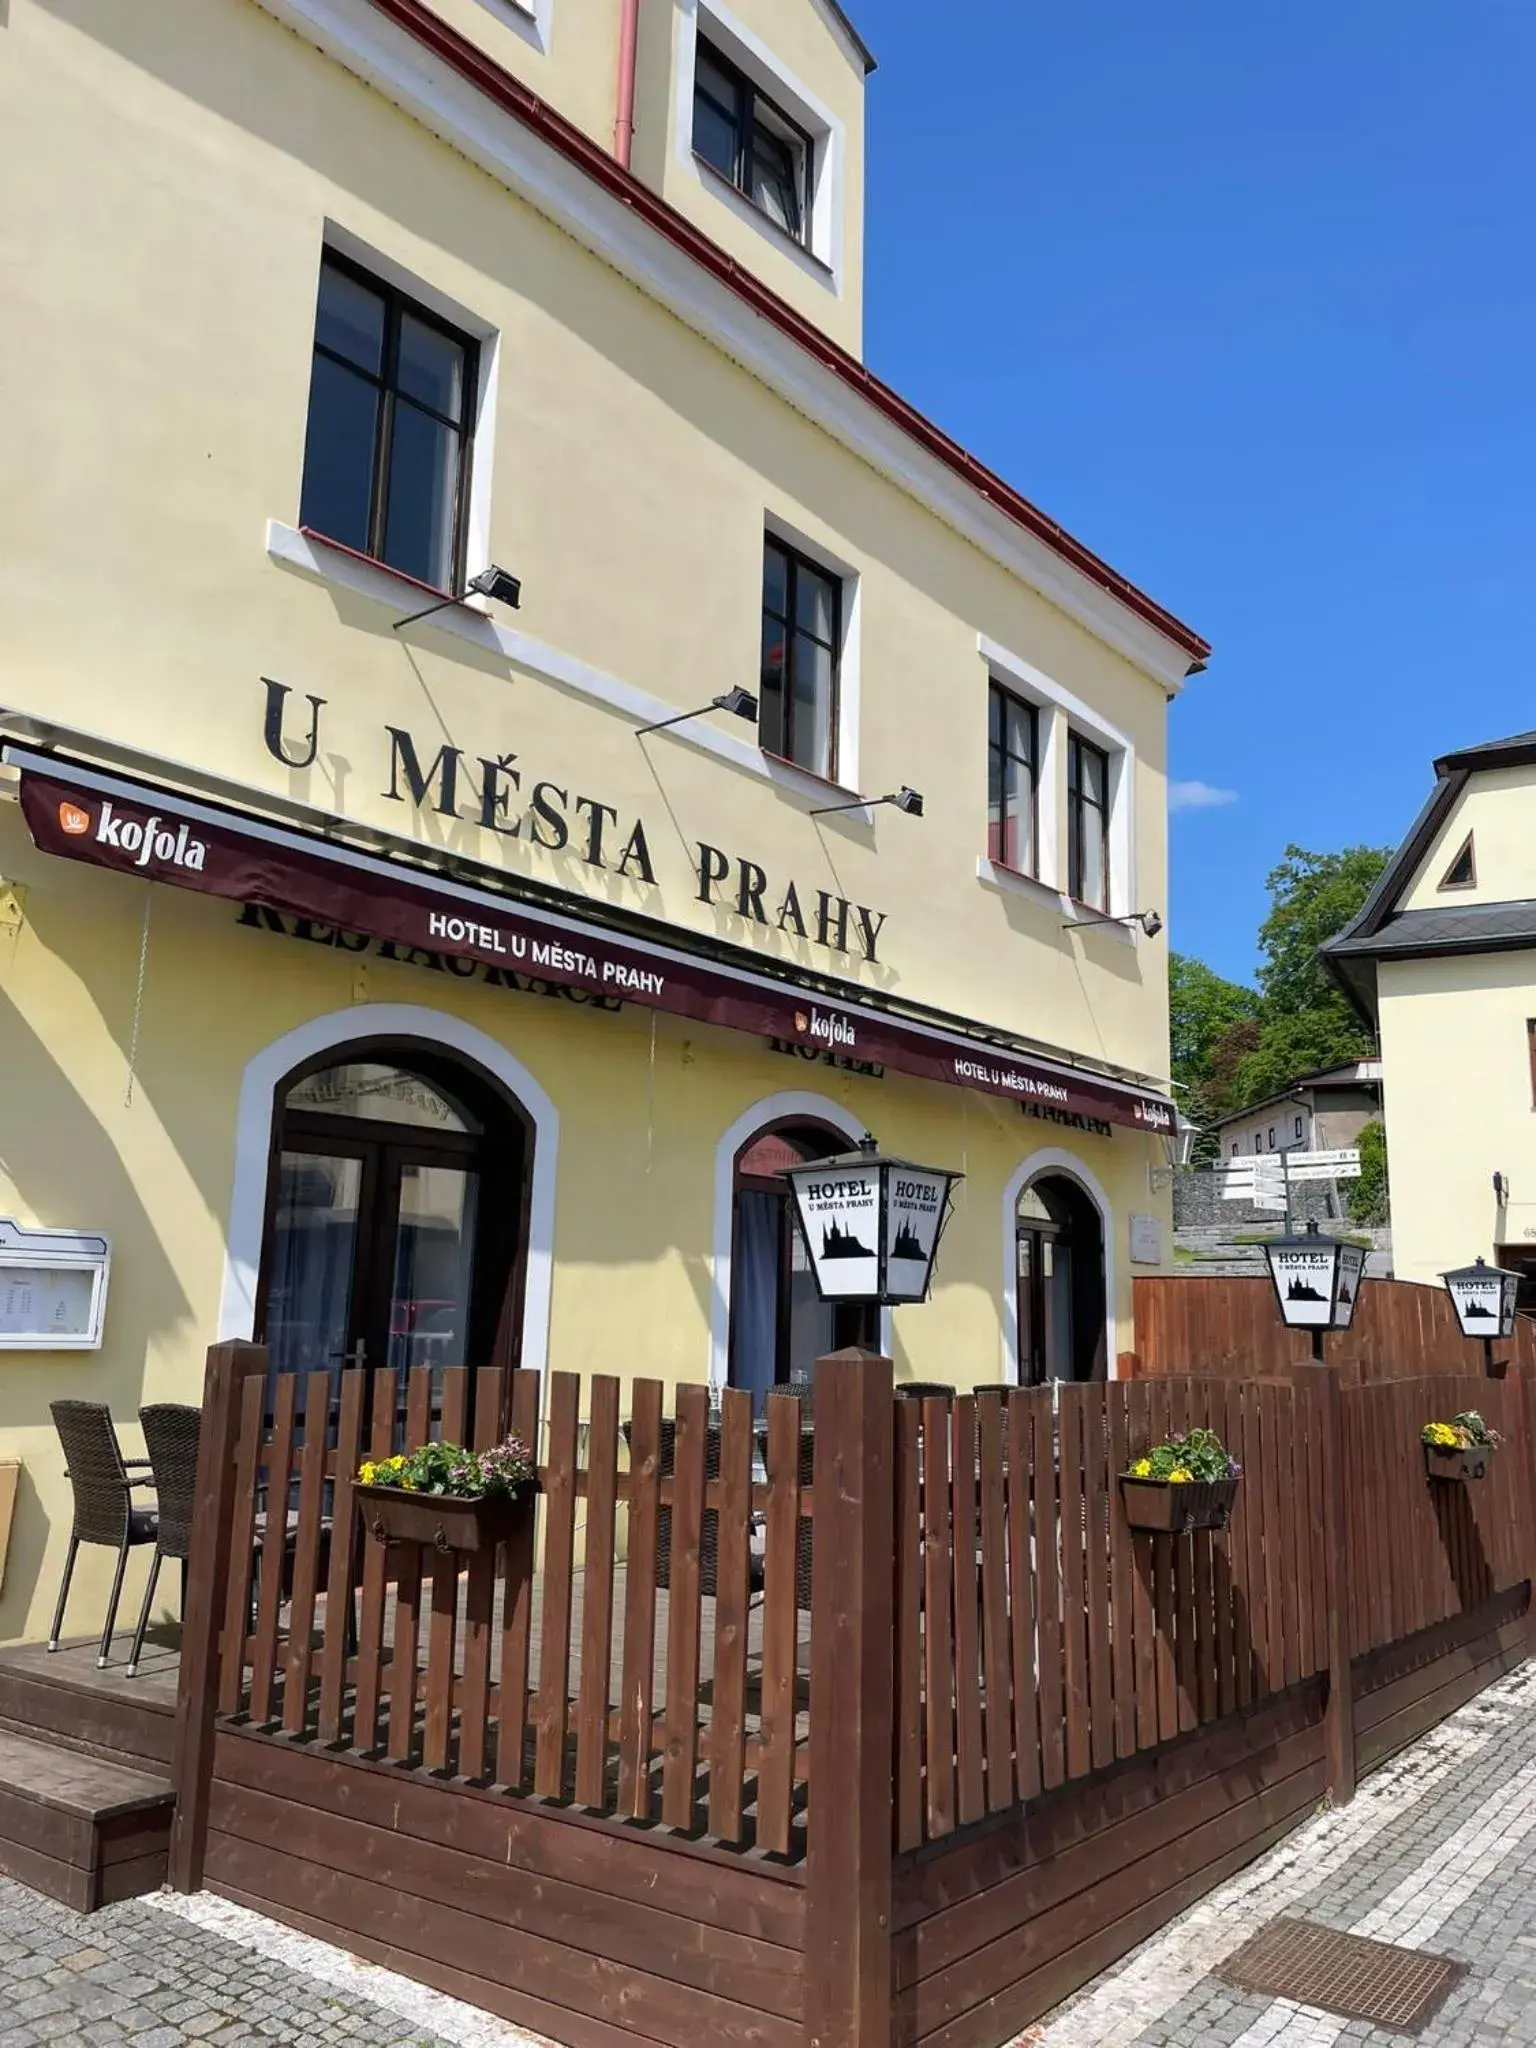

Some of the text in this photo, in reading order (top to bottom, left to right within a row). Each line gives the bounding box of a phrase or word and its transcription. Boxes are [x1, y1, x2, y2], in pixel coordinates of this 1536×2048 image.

[260, 677, 327, 768] U
[381, 725, 658, 885] MĚSTA
[695, 841, 888, 963] PRAHY
[96, 801, 204, 871] kofola
[429, 912, 665, 995] HOTEL U MĚSTA PRAHY
[810, 1007, 857, 1047] kofola
[955, 1059, 1069, 1102] HOTEL U MĚSTA PRAHY
[808, 1180, 872, 1200] HOTEL
[808, 1199, 874, 1212] U MĚSTA PRAHY
[895, 1180, 938, 1202] HOTEL
[1279, 1252, 1328, 1263] HOTEL
[1457, 1281, 1496, 1290] HOTEL
